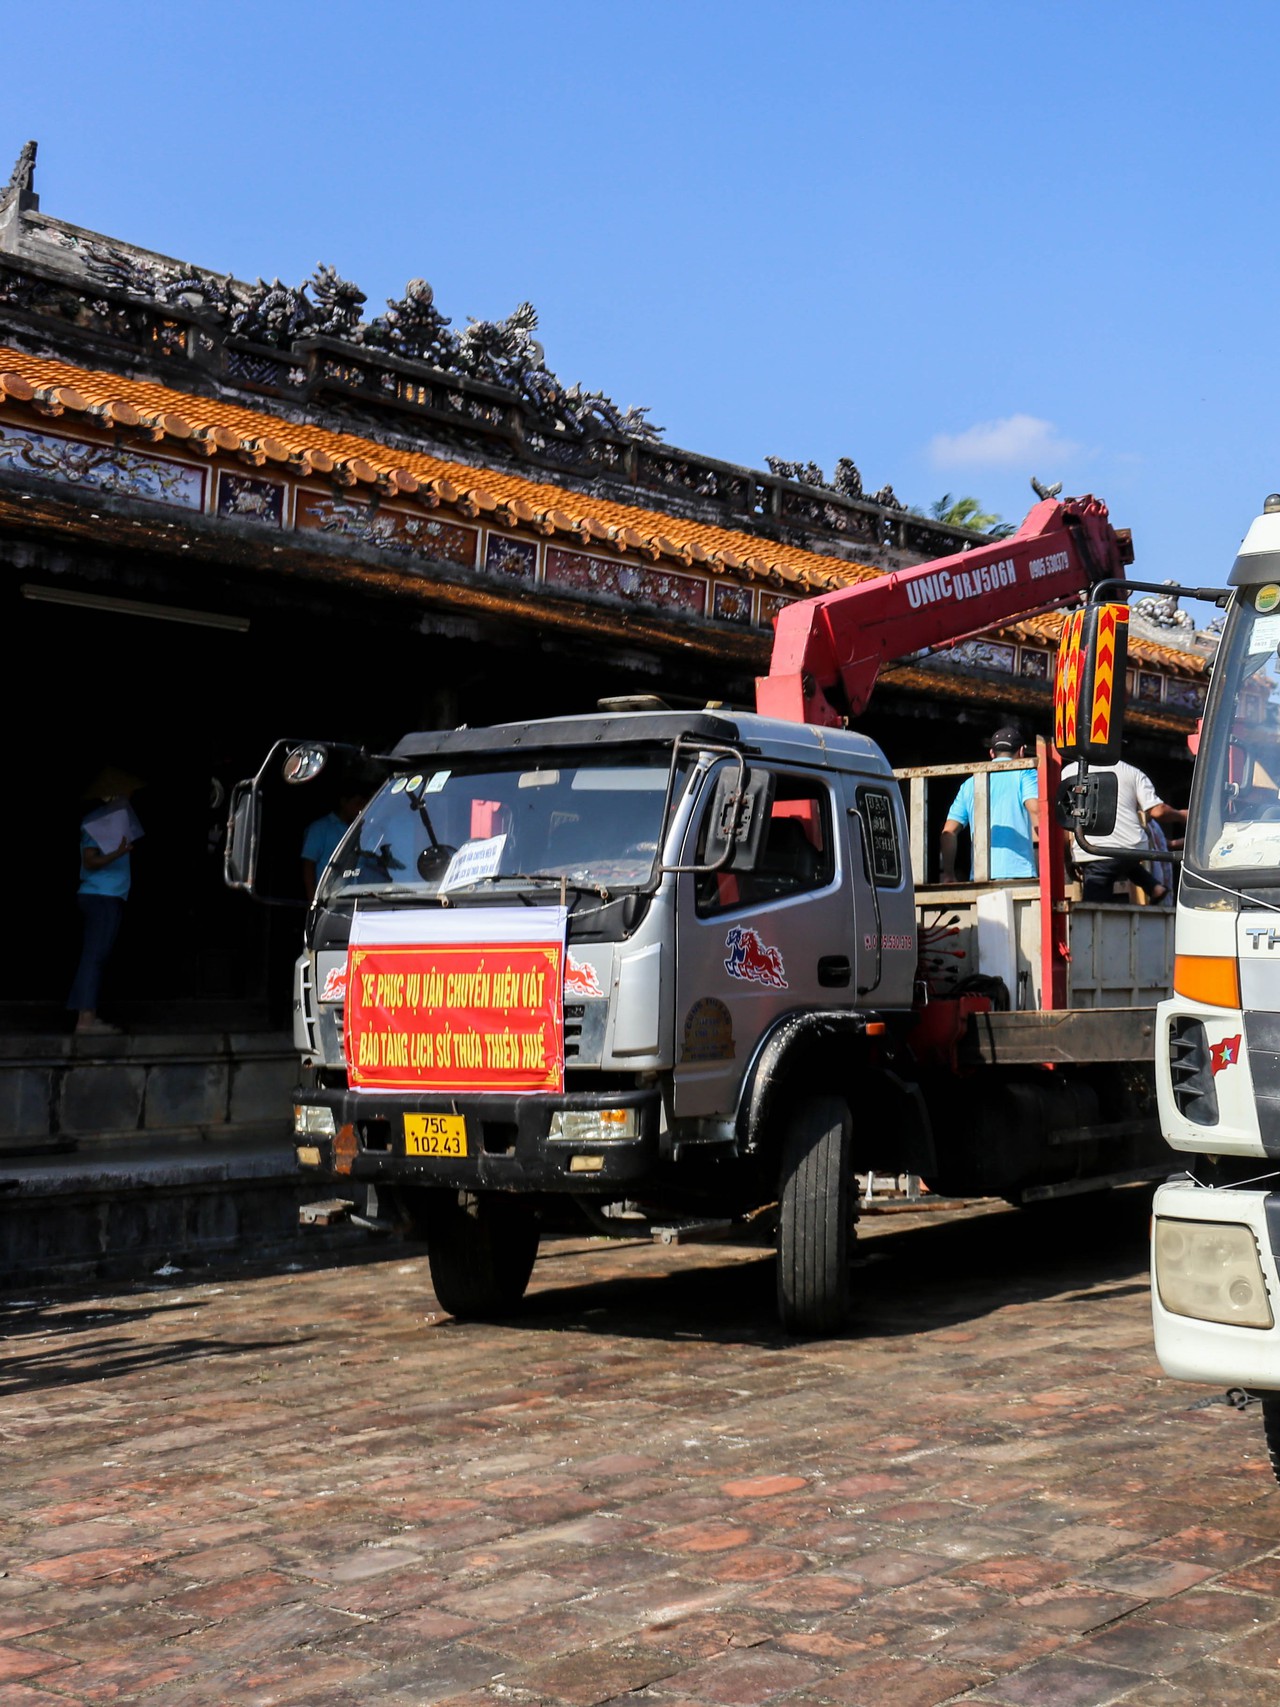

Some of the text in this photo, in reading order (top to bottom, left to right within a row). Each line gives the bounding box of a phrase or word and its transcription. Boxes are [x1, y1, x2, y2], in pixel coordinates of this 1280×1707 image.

[906, 570, 953, 609] UNIC
[361, 958, 545, 1016] XE PHỤC VỤ VẬN CHUYỂN HIỆN VẬT
[358, 1020, 546, 1075] BẢO TÀNG LỊCH SỬ THỪA THIÊN HUẾ
[413, 1136, 461, 1154] 102.43
[421, 1117, 448, 1134] 75C
